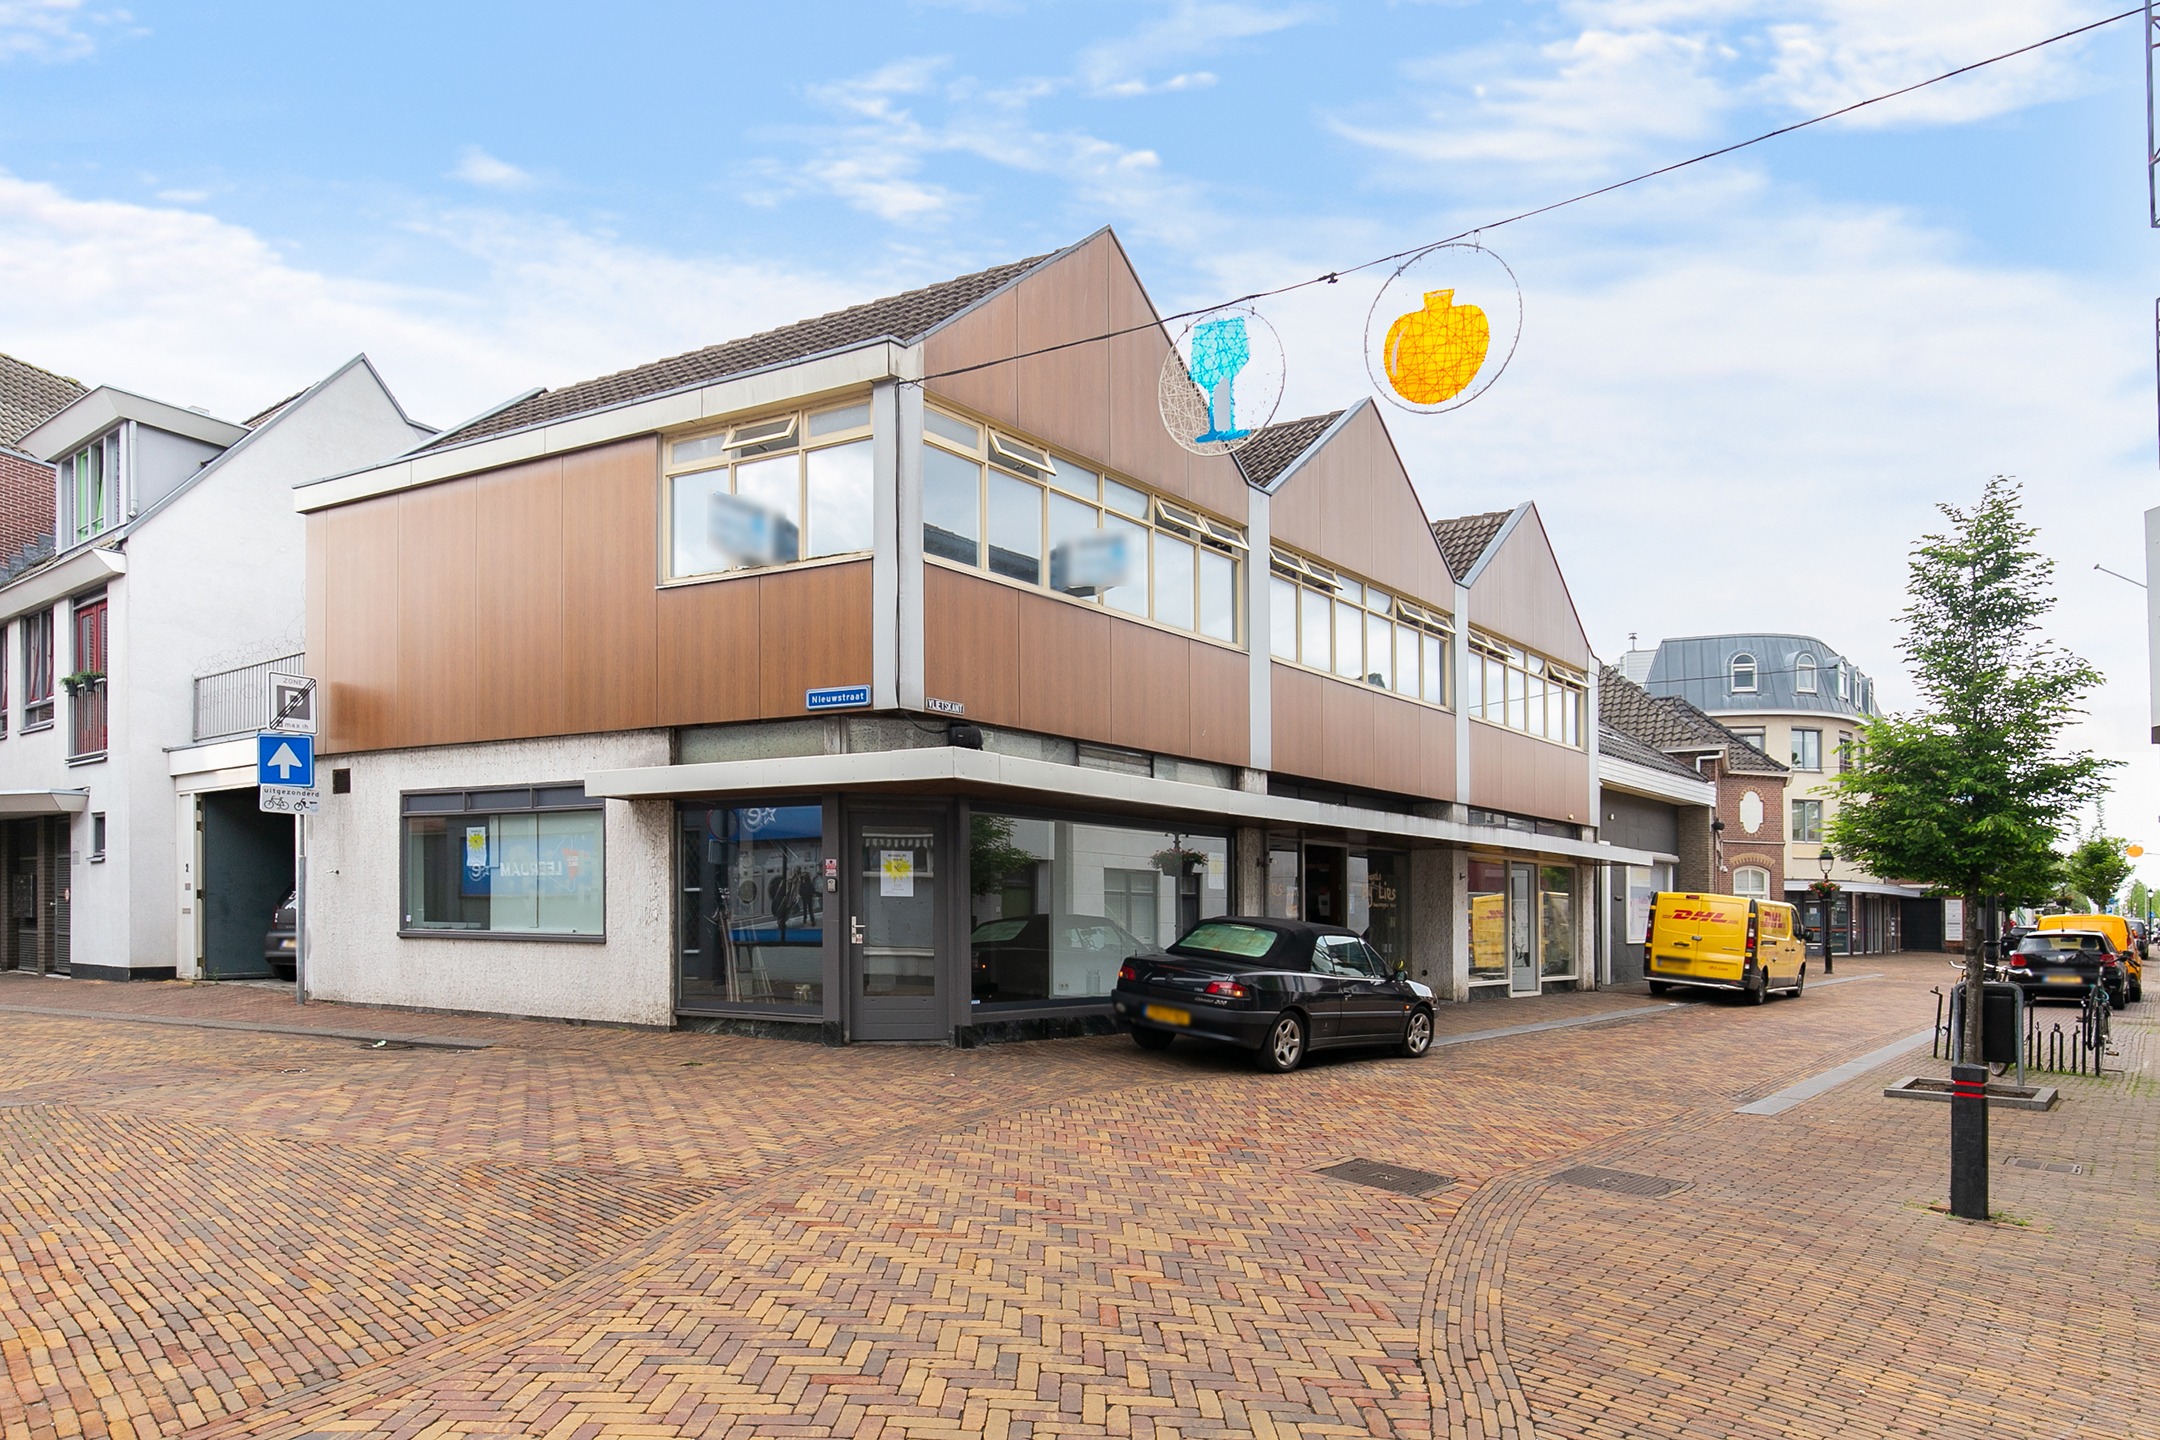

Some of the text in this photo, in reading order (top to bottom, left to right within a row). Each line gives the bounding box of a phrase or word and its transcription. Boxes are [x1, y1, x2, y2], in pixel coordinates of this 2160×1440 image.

[283, 677, 304, 686] ZONE
[811, 692, 864, 704] Nieuwstraat
[263, 787, 320, 798] uitgezonderd
[1672, 909, 1728, 924] DHL
